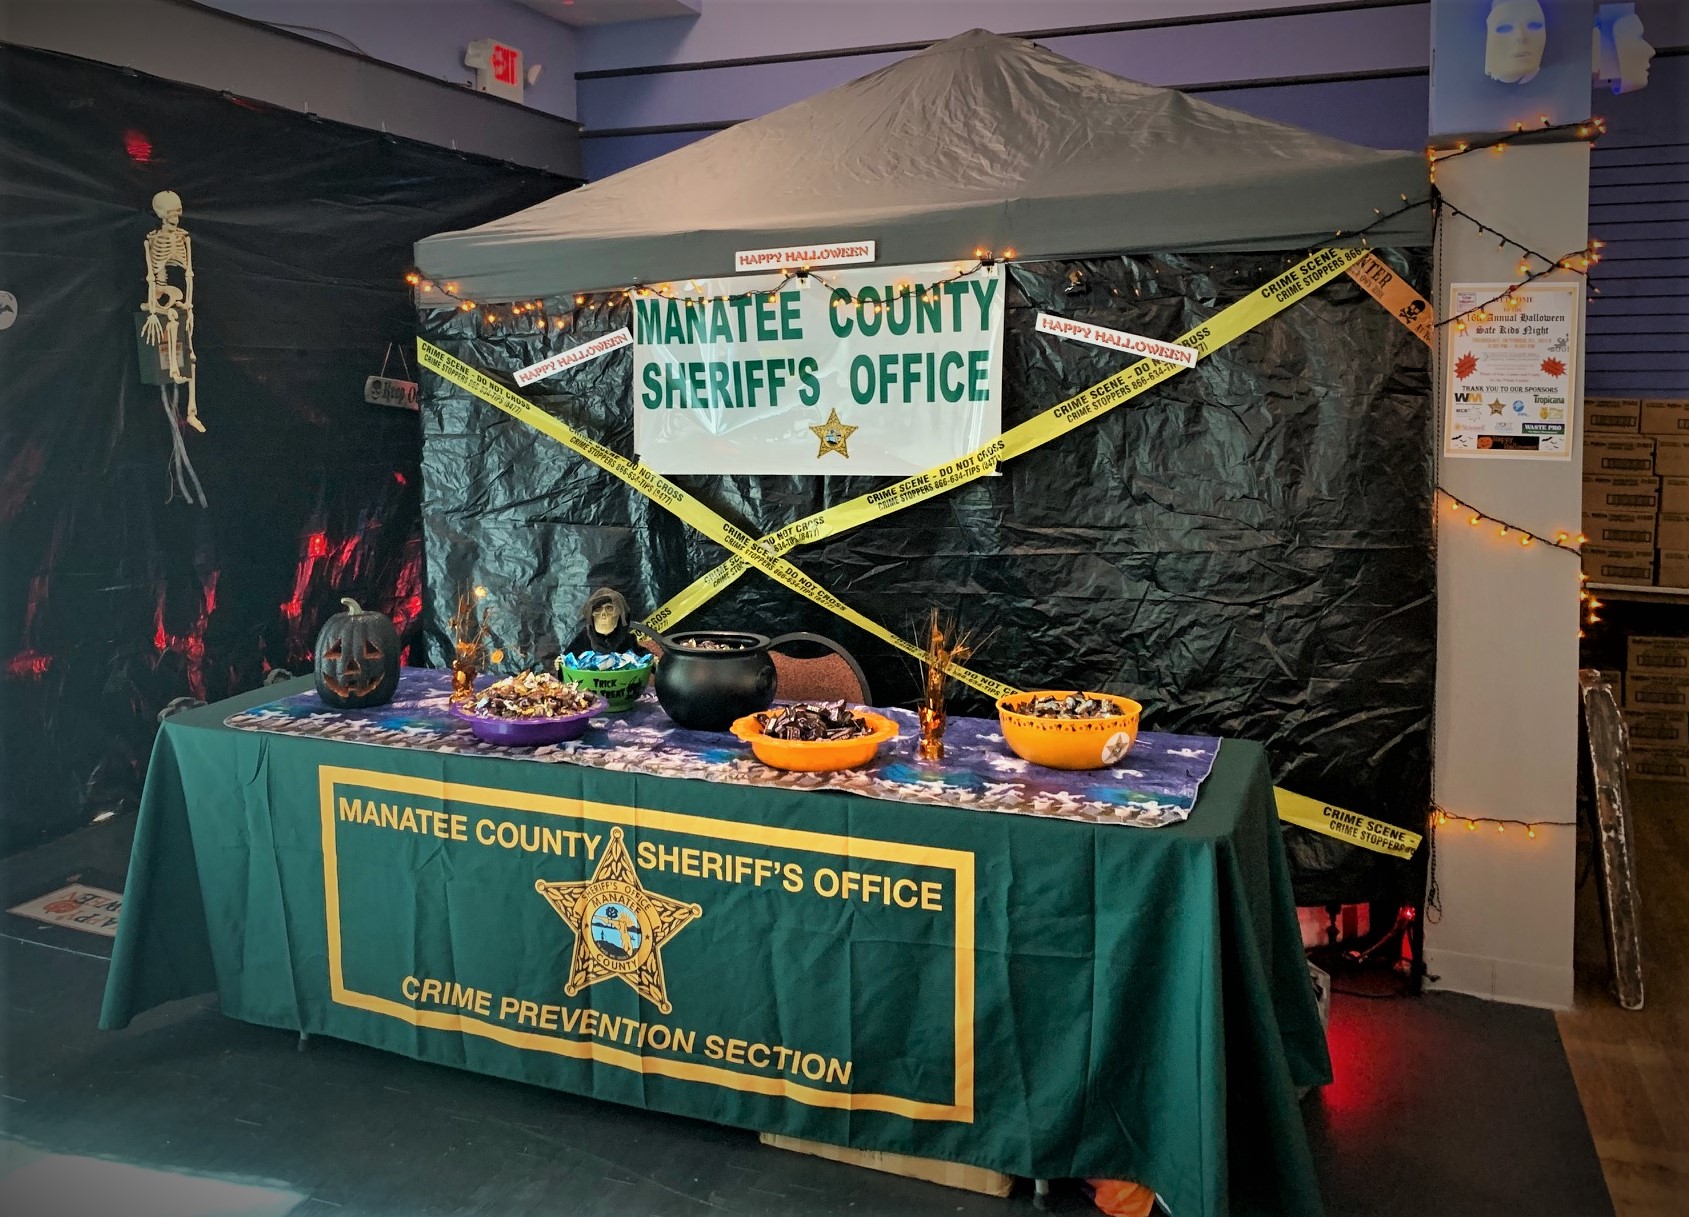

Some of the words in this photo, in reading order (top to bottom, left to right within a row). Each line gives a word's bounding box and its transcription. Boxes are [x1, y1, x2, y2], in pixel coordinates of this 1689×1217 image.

[493, 45, 518, 85] EXIT
[740, 251, 782, 266] HAPPY
[785, 245, 869, 262] HALLOWEEN
[1261, 270, 1299, 298] CRIME
[1300, 248, 1338, 275] SCENE
[1276, 282, 1304, 303] CRIME
[1305, 258, 1345, 287] STOPPERS
[637, 291, 804, 345] MANATEE
[828, 279, 999, 338] COUNTY
[1487, 313, 1517, 322] Annual
[1520, 313, 1565, 323] Halloween
[1042, 317, 1092, 339] HAPPY
[1095, 330, 1192, 364] HALLOWEEN
[1178, 327, 1211, 347] ROSS
[1476, 325, 1496, 335] Safe
[1500, 325, 1520, 334] Kids
[1522, 325, 1549, 336] Night
[424, 353, 442, 368] CRIME
[442, 364, 469, 384] STOPPERS
[519, 363, 557, 382] HAPPY
[557, 333, 629, 367] HALLOWEEN
[421, 342, 445, 361] CRIME
[446, 355, 470, 375] SCENE
[477, 375, 487, 385] DO
[489, 382, 504, 394] NOT
[505, 393, 531, 410] CROSS
[641, 356, 820, 409] SHERIFF'S
[850, 350, 990, 405] OFFICE
[1053, 396, 1089, 419] CRIME
[1090, 377, 1126, 400] SCENE
[1134, 362, 1150, 376] DO
[1067, 405, 1093, 423] CRIME
[1093, 387, 1132, 411] STOPPERS
[1533, 394, 1565, 405] Tropicana
[569, 436, 590, 451] CRIME
[588, 445, 617, 468] STOPPERS
[639, 468, 656, 483] NOT
[656, 479, 685, 502] CROSS
[867, 487, 898, 505] CRIME
[899, 473, 931, 493] SCENE
[939, 465, 953, 477] DO
[956, 456, 975, 472] NOT
[976, 440, 1005, 461] CROSS
[878, 495, 900, 511] CRIME
[900, 484, 934, 503] STOPPERS
[934, 465, 981, 490] 866-634-TIPS
[776, 526, 793, 540] NOT
[722, 522, 750, 546] CRIME
[750, 542, 780, 566] SCENE
[785, 567, 799, 579] DO
[799, 577, 818, 592] NOT
[817, 589, 847, 611] CROSS
[724, 535, 746, 552] CRIME
[744, 549, 775, 572] STOPPERS
[713, 572, 730, 588] CRIME
[645, 606, 672, 630] CROSS
[593, 679, 617, 688] TRICK
[963, 670, 979, 680] DO
[980, 677, 1001, 690] NOT
[1323, 806, 1365, 828] CRIME
[1366, 821, 1406, 842] SCENE
[1329, 820, 1359, 838] CRIME
[1360, 831, 1406, 853] STOPPERS
[338, 796, 468, 842] MANATEE
[475, 818, 602, 860] COUNTY
[636, 841, 805, 894] SHERIFF'S
[813, 867, 944, 912] OFFICE
[582, 881, 618, 901] SHERIFF'S
[624, 885, 652, 911] OFFICE
[591, 893, 642, 914] MANATEE
[596, 953, 639, 971] COUNTY
[401, 975, 493, 1017] CRIME
[499, 997, 696, 1054] PREVENTION
[704, 1034, 853, 1086] SECTION
